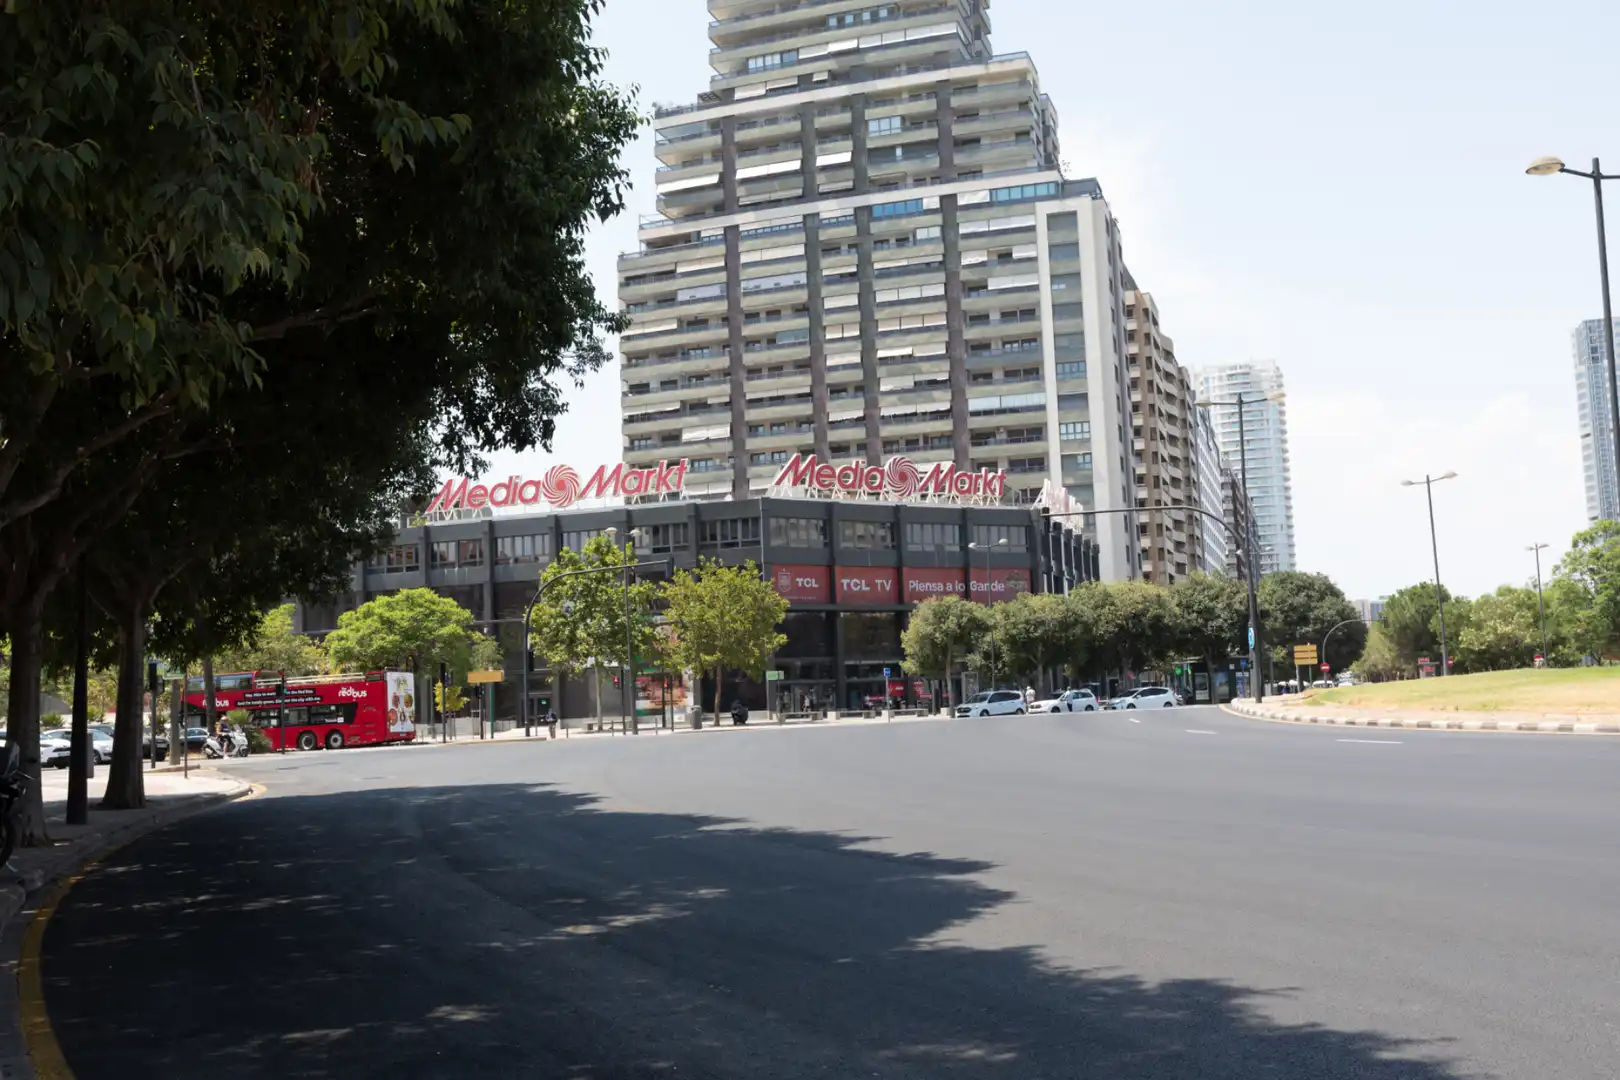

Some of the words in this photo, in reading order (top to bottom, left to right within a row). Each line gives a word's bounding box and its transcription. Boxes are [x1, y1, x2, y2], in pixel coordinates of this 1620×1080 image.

[775, 453, 885, 492] Media
[918, 463, 1006, 497] Markt
[425, 476, 543, 514] Media
[578, 458, 690, 500] Markt
[796, 577, 819, 588] TCL
[841, 578, 870, 592] TCL
[875, 579, 892, 593] TV
[908, 580, 944, 593] Piensa
[946, 584, 953, 592] a
[955, 580, 966, 593] lo
